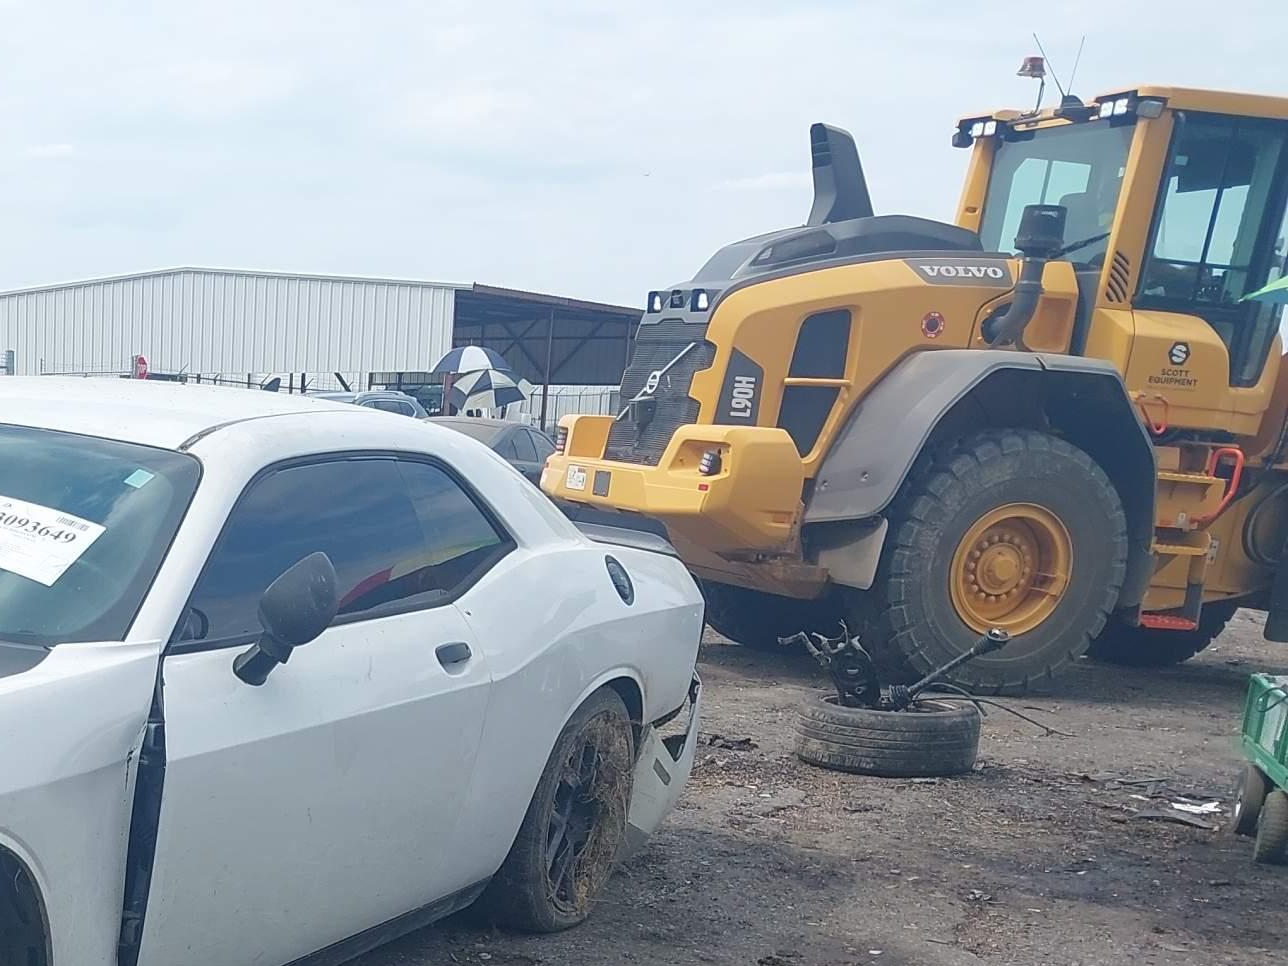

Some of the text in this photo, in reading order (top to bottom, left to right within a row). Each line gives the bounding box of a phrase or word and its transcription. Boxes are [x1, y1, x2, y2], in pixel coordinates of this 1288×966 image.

[920, 265, 1004, 279] VOLVO
[1160, 368, 1191, 377] SCOTT
[1148, 375, 1198, 386] EQUIPMENT
[729, 375, 757, 417] L90H
